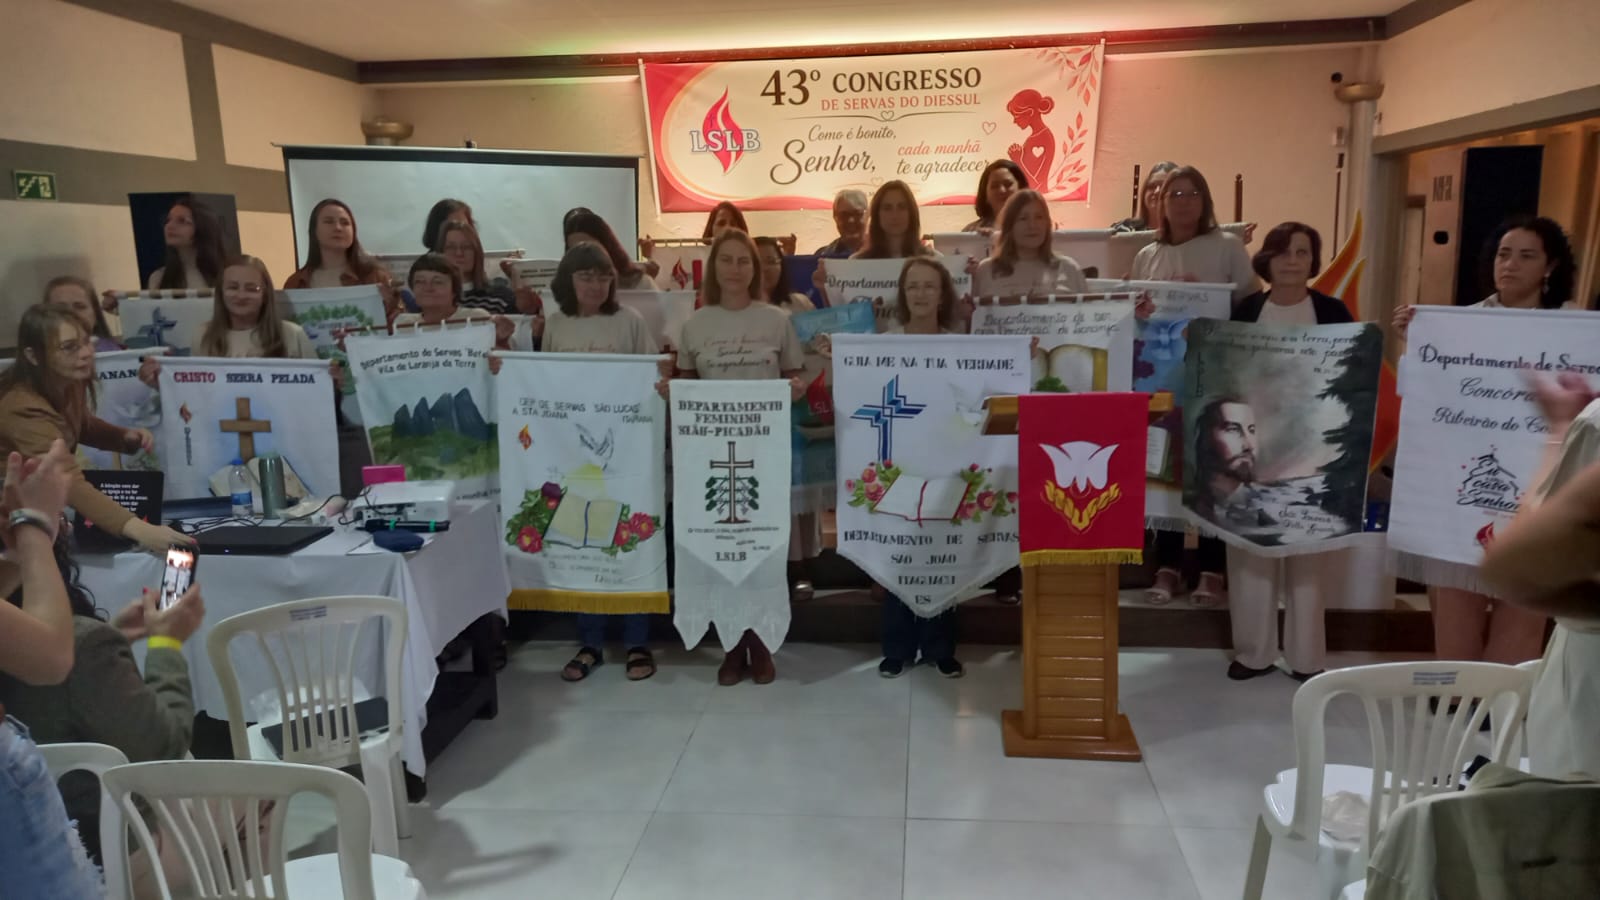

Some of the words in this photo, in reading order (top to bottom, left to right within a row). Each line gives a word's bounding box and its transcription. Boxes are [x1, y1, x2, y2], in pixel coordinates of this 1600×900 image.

[832, 67, 982, 93] CONGRESSO
[821, 98, 839, 111] DE
[843, 95, 895, 110] SERVAS
[900, 94, 919, 108] DO
[924, 93, 981, 107] DIESSUL
[689, 128, 761, 153] LSLB
[808, 124, 844, 142] Como
[846, 127, 854, 140] é
[856, 125, 897, 140] bonito,
[897, 141, 930, 156] cada
[934, 139, 982, 154] manhã
[769, 138, 877, 185] Senhor,
[896, 158, 911, 175] te
[914, 155, 989, 182] agradecer
[826, 274, 899, 293] Departamen
[378, 364, 394, 374] Vila
[408, 361, 440, 370] Laranja
[454, 359, 476, 368] Terra
[844, 356, 870, 367] GUIA
[876, 356, 896, 367] ME
[900, 356, 918, 367] NA
[923, 357, 947, 369] TUA
[956, 358, 1014, 370] VERDADE
[1419, 343, 1531, 370] Departamento
[1534, 352, 1553, 371] de
[1556, 353, 1600, 375] Serva
[99, 369, 138, 380] ANAN
[173, 371, 216, 383] CRISTO
[226, 372, 263, 383] SERRA
[271, 373, 315, 384] PELADA
[678, 400, 783, 412] DEPARTAMENTO
[695, 413, 761, 424] FEMININO
[1432, 406, 1498, 429] Ribeirão
[1501, 416, 1519, 431] do
[1472, 480, 1510, 492] casa
[844, 530, 933, 546] DEPARTAMENTO
[946, 534, 963, 545] DE
[977, 532, 1020, 545] SERVAS
[715, 551, 747, 561] LSLB
[915, 594, 931, 605] ES
